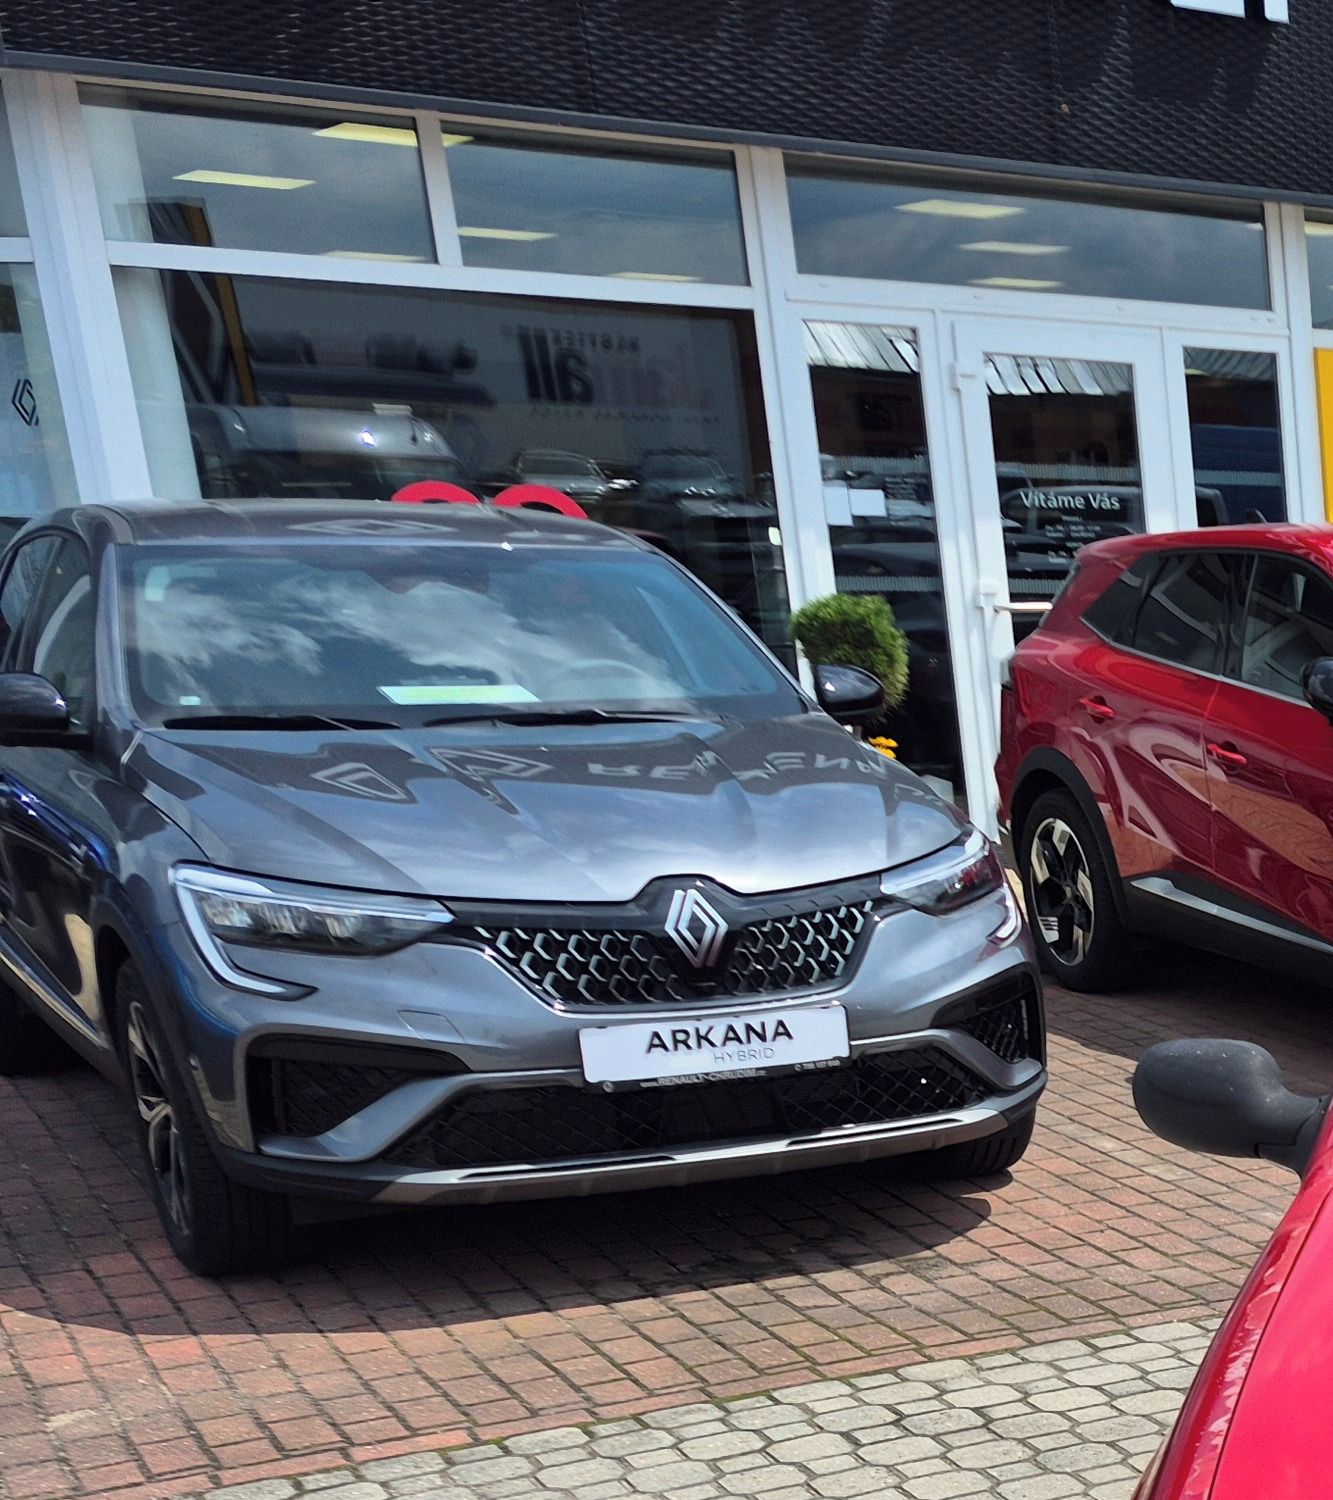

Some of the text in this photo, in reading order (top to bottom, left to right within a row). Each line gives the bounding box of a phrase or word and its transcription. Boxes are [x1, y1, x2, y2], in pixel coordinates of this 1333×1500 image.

[1020, 490, 1120, 511] Vítáme Vás
[646, 1019, 794, 1054] ARKANA
[713, 1047, 775, 1063] HYBRID
